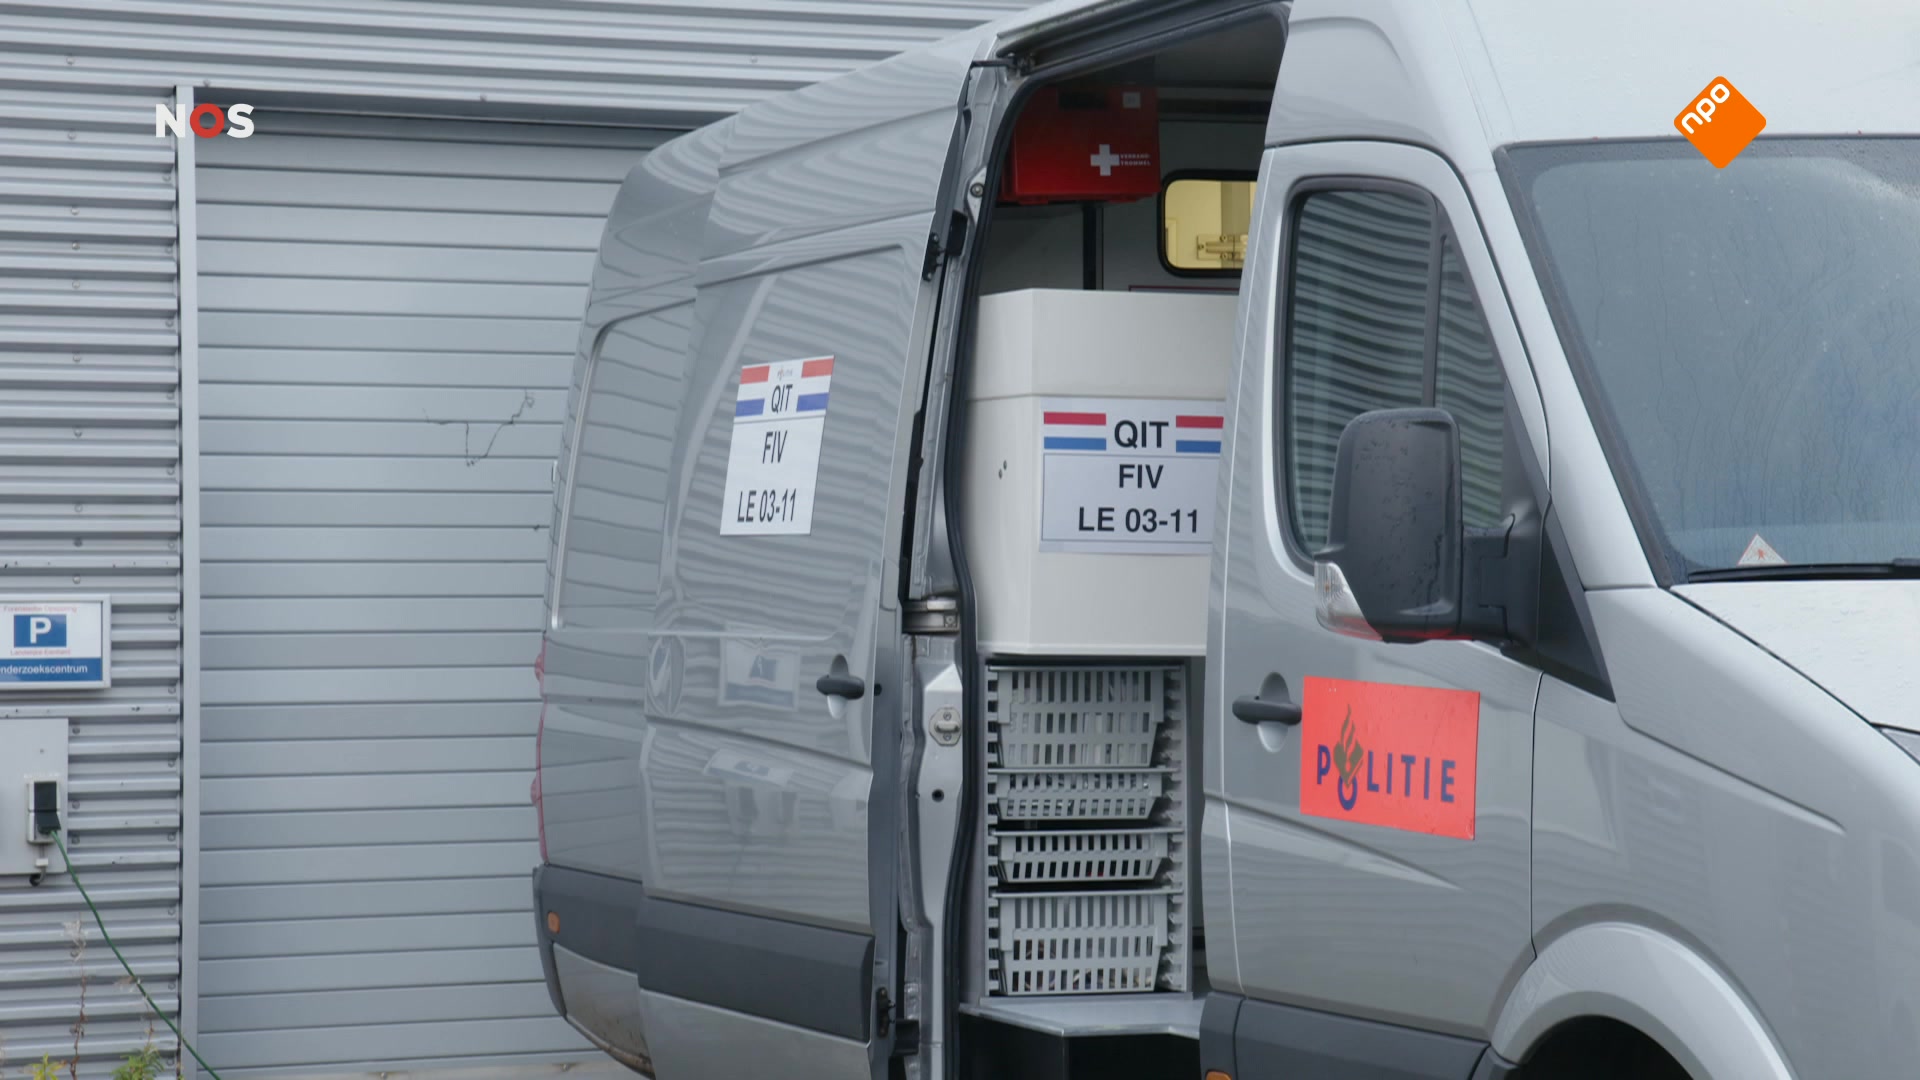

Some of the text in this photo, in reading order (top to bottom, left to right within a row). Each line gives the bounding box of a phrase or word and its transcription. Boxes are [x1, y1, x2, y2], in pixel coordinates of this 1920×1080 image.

[771, 384, 793, 413] QIT
[762, 430, 788, 464] FIV
[1114, 420, 1169, 449] QIT
[1119, 464, 1164, 489] FIV
[737, 488, 797, 523] LE 03-11
[1078, 506, 1198, 533] LE 03-11
[30, 616, 52, 644] P
[0, 664, 88, 674] nderzoekscentrum
[1315, 743, 1456, 812] POLITIE
